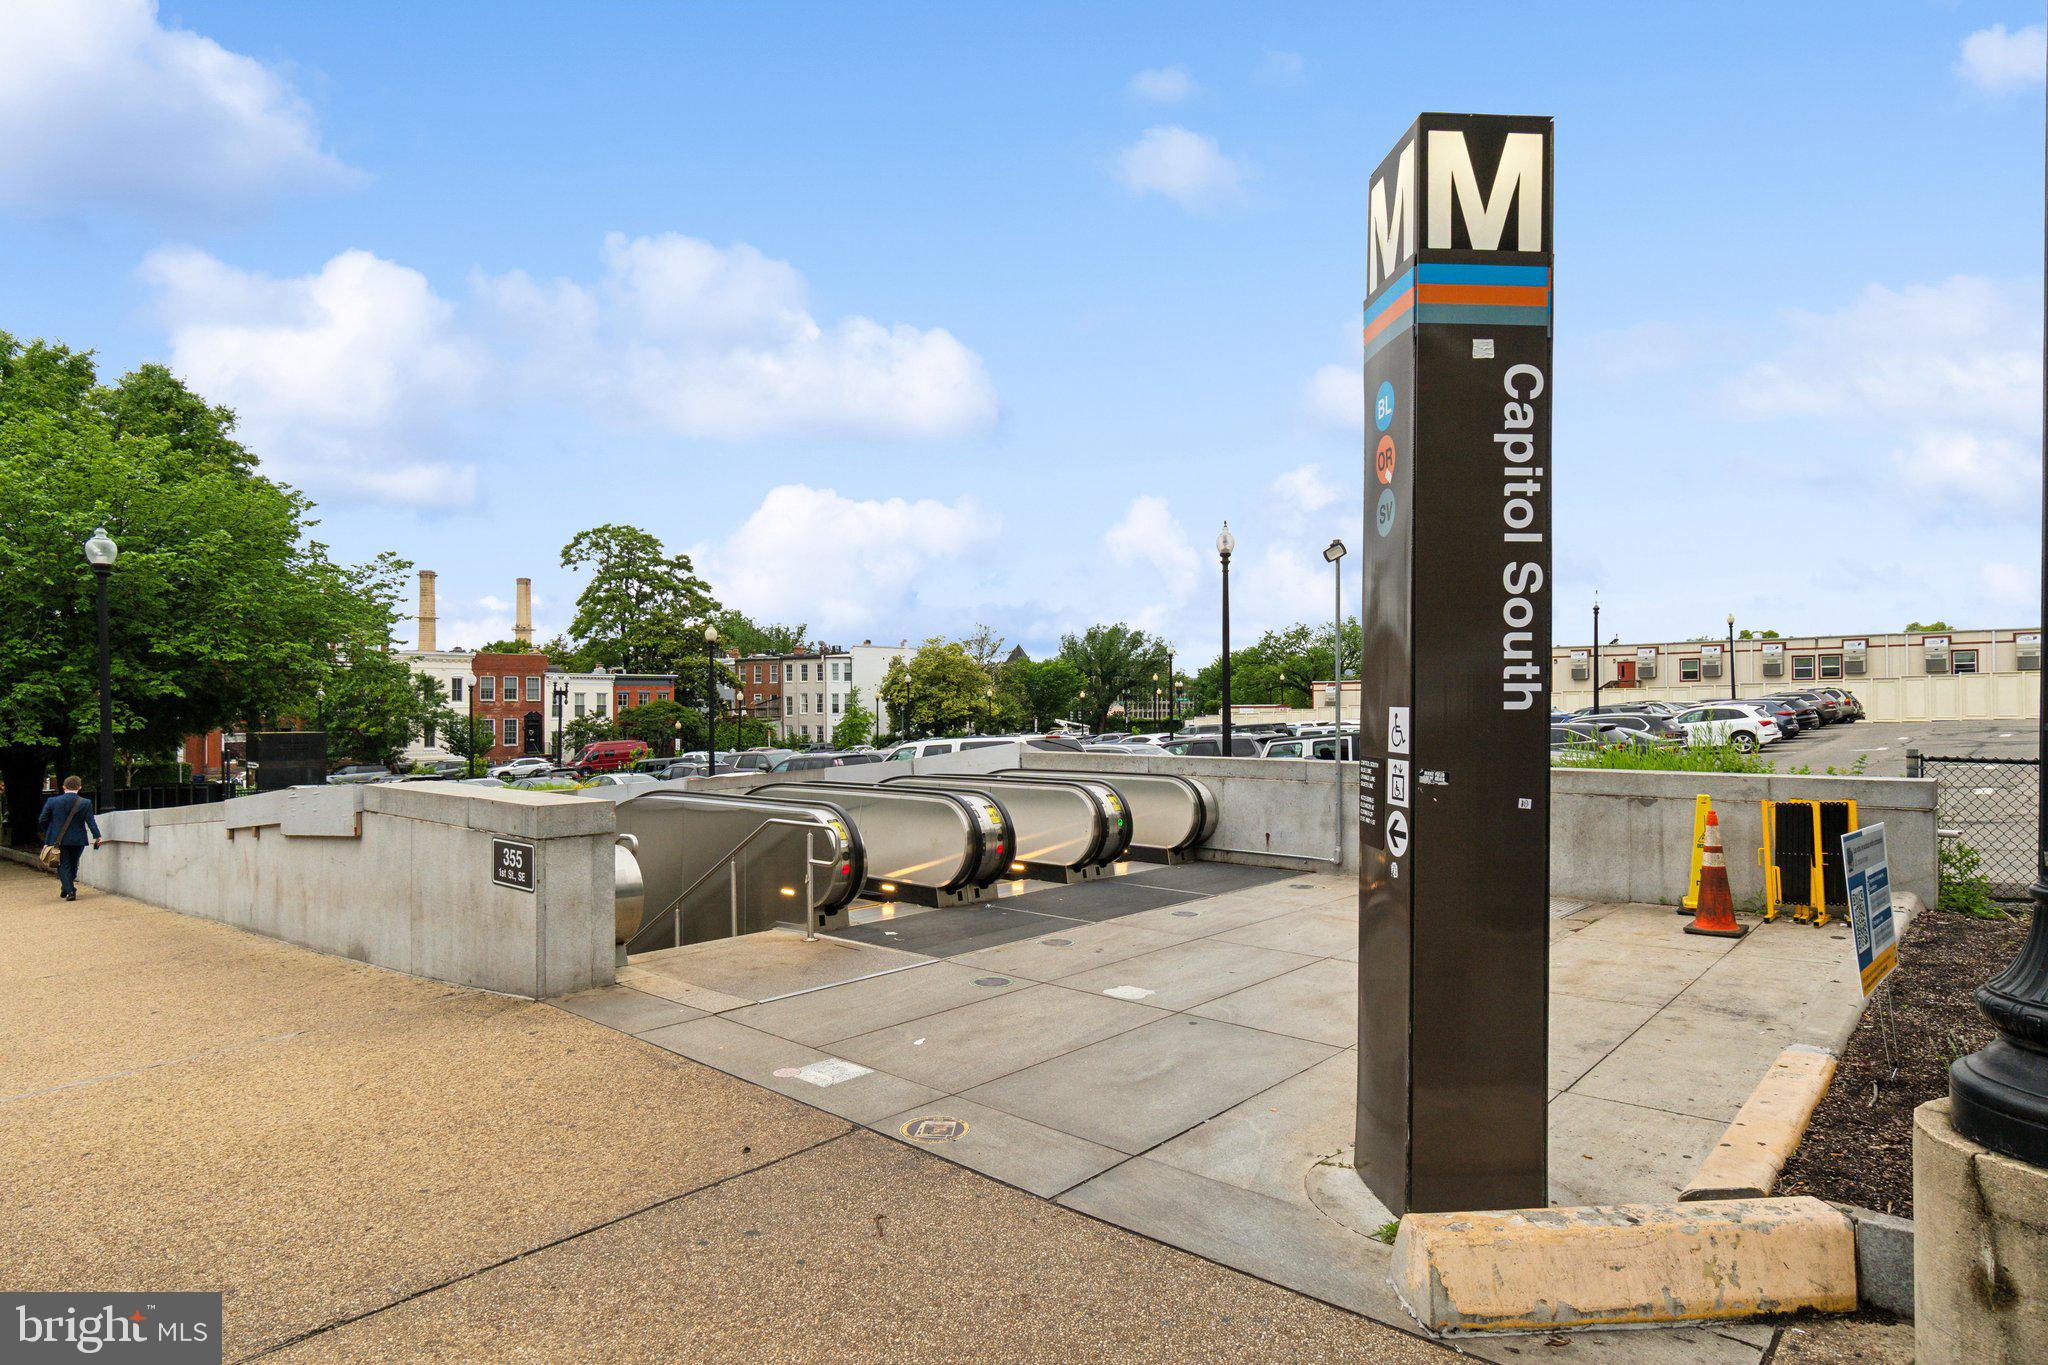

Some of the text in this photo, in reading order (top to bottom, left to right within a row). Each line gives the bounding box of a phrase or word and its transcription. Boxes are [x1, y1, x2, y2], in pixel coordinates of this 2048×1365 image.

[1427, 130, 1543, 252] M
[1368, 138, 1415, 296] M
[1378, 396, 1392, 420] BL
[1377, 447, 1393, 472] OR
[1379, 501, 1393, 525] SV
[1493, 363, 1544, 711] Capitol South
[503, 848, 523, 868] 355
[498, 867, 507, 878] 1st
[518, 871, 525, 882] SE
